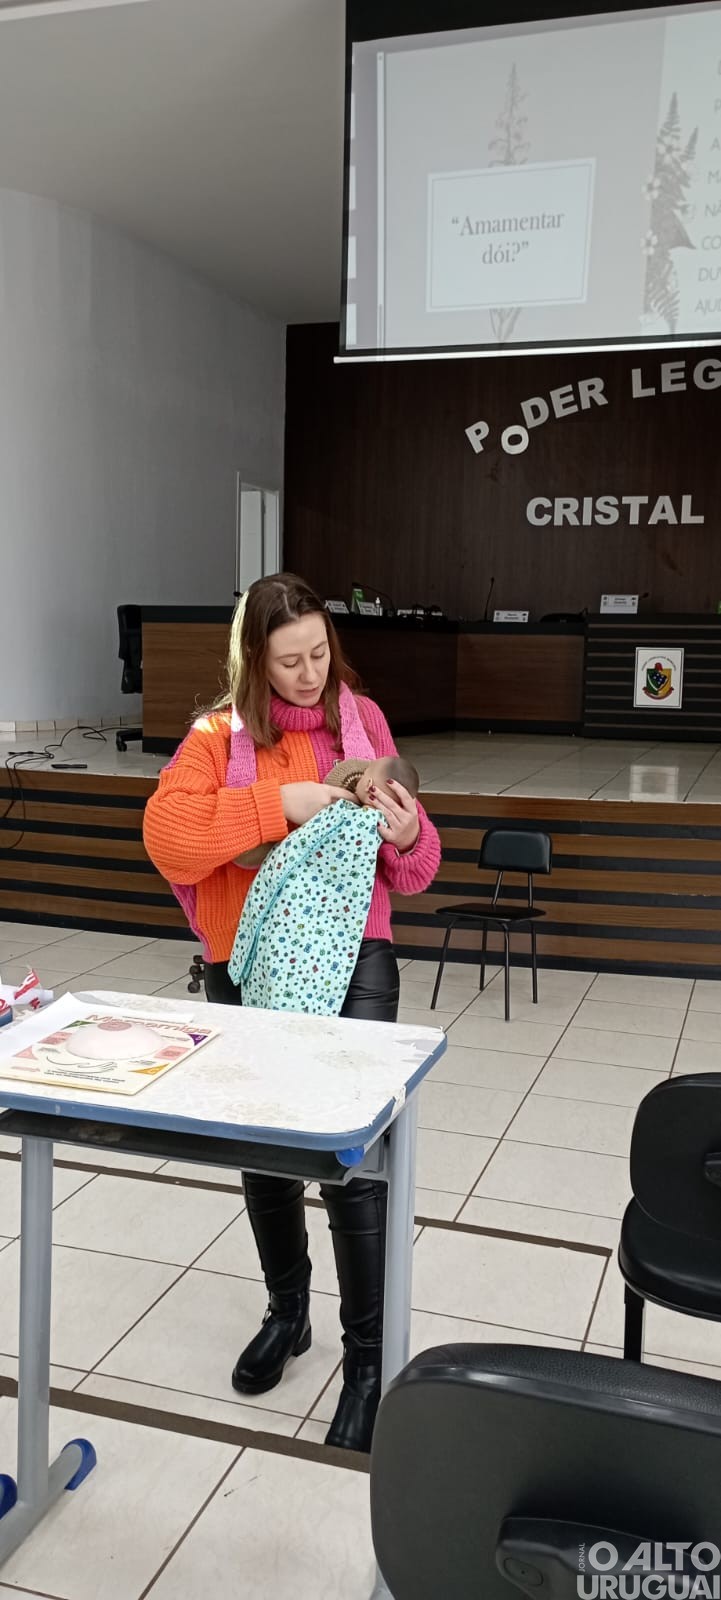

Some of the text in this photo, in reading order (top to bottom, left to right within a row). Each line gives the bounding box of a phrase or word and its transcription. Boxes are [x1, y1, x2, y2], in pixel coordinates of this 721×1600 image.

[464, 358, 721, 456] PODER LEG
[525, 494, 705, 527] CRISTAL
